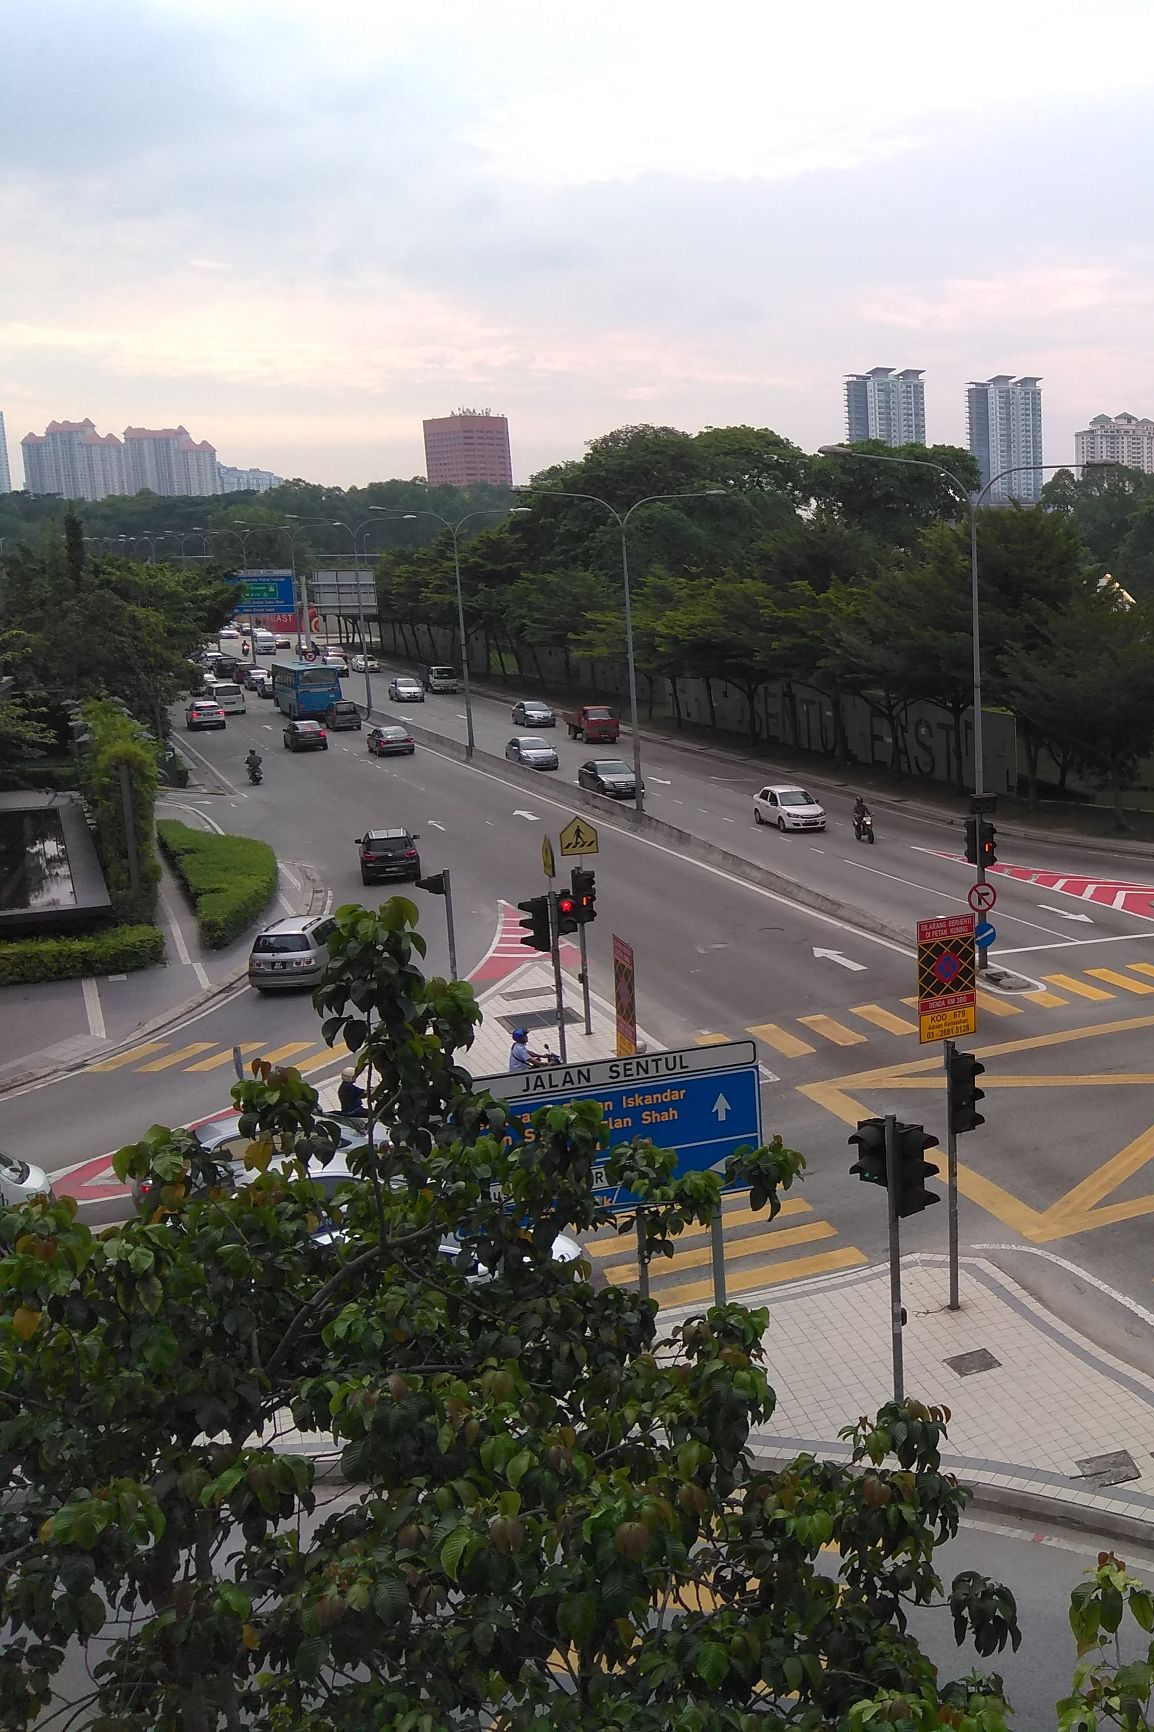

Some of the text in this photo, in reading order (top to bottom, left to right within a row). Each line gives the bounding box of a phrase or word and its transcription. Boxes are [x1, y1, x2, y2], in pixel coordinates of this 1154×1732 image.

[920, 917, 972, 932] DILARANG BERHENTI
[931, 928, 948, 938] PETAK
[949, 925, 968, 935] KUNING
[928, 1000, 946, 1010] DENDA
[956, 995, 967, 1004] 300
[930, 1013, 947, 1024] KOD
[927, 1023, 944, 1031] Aduan
[522, 1054, 689, 1093] JALAN SENTUL
[622, 1088, 687, 1109] Iskandar
[641, 1107, 678, 1125] Shah
